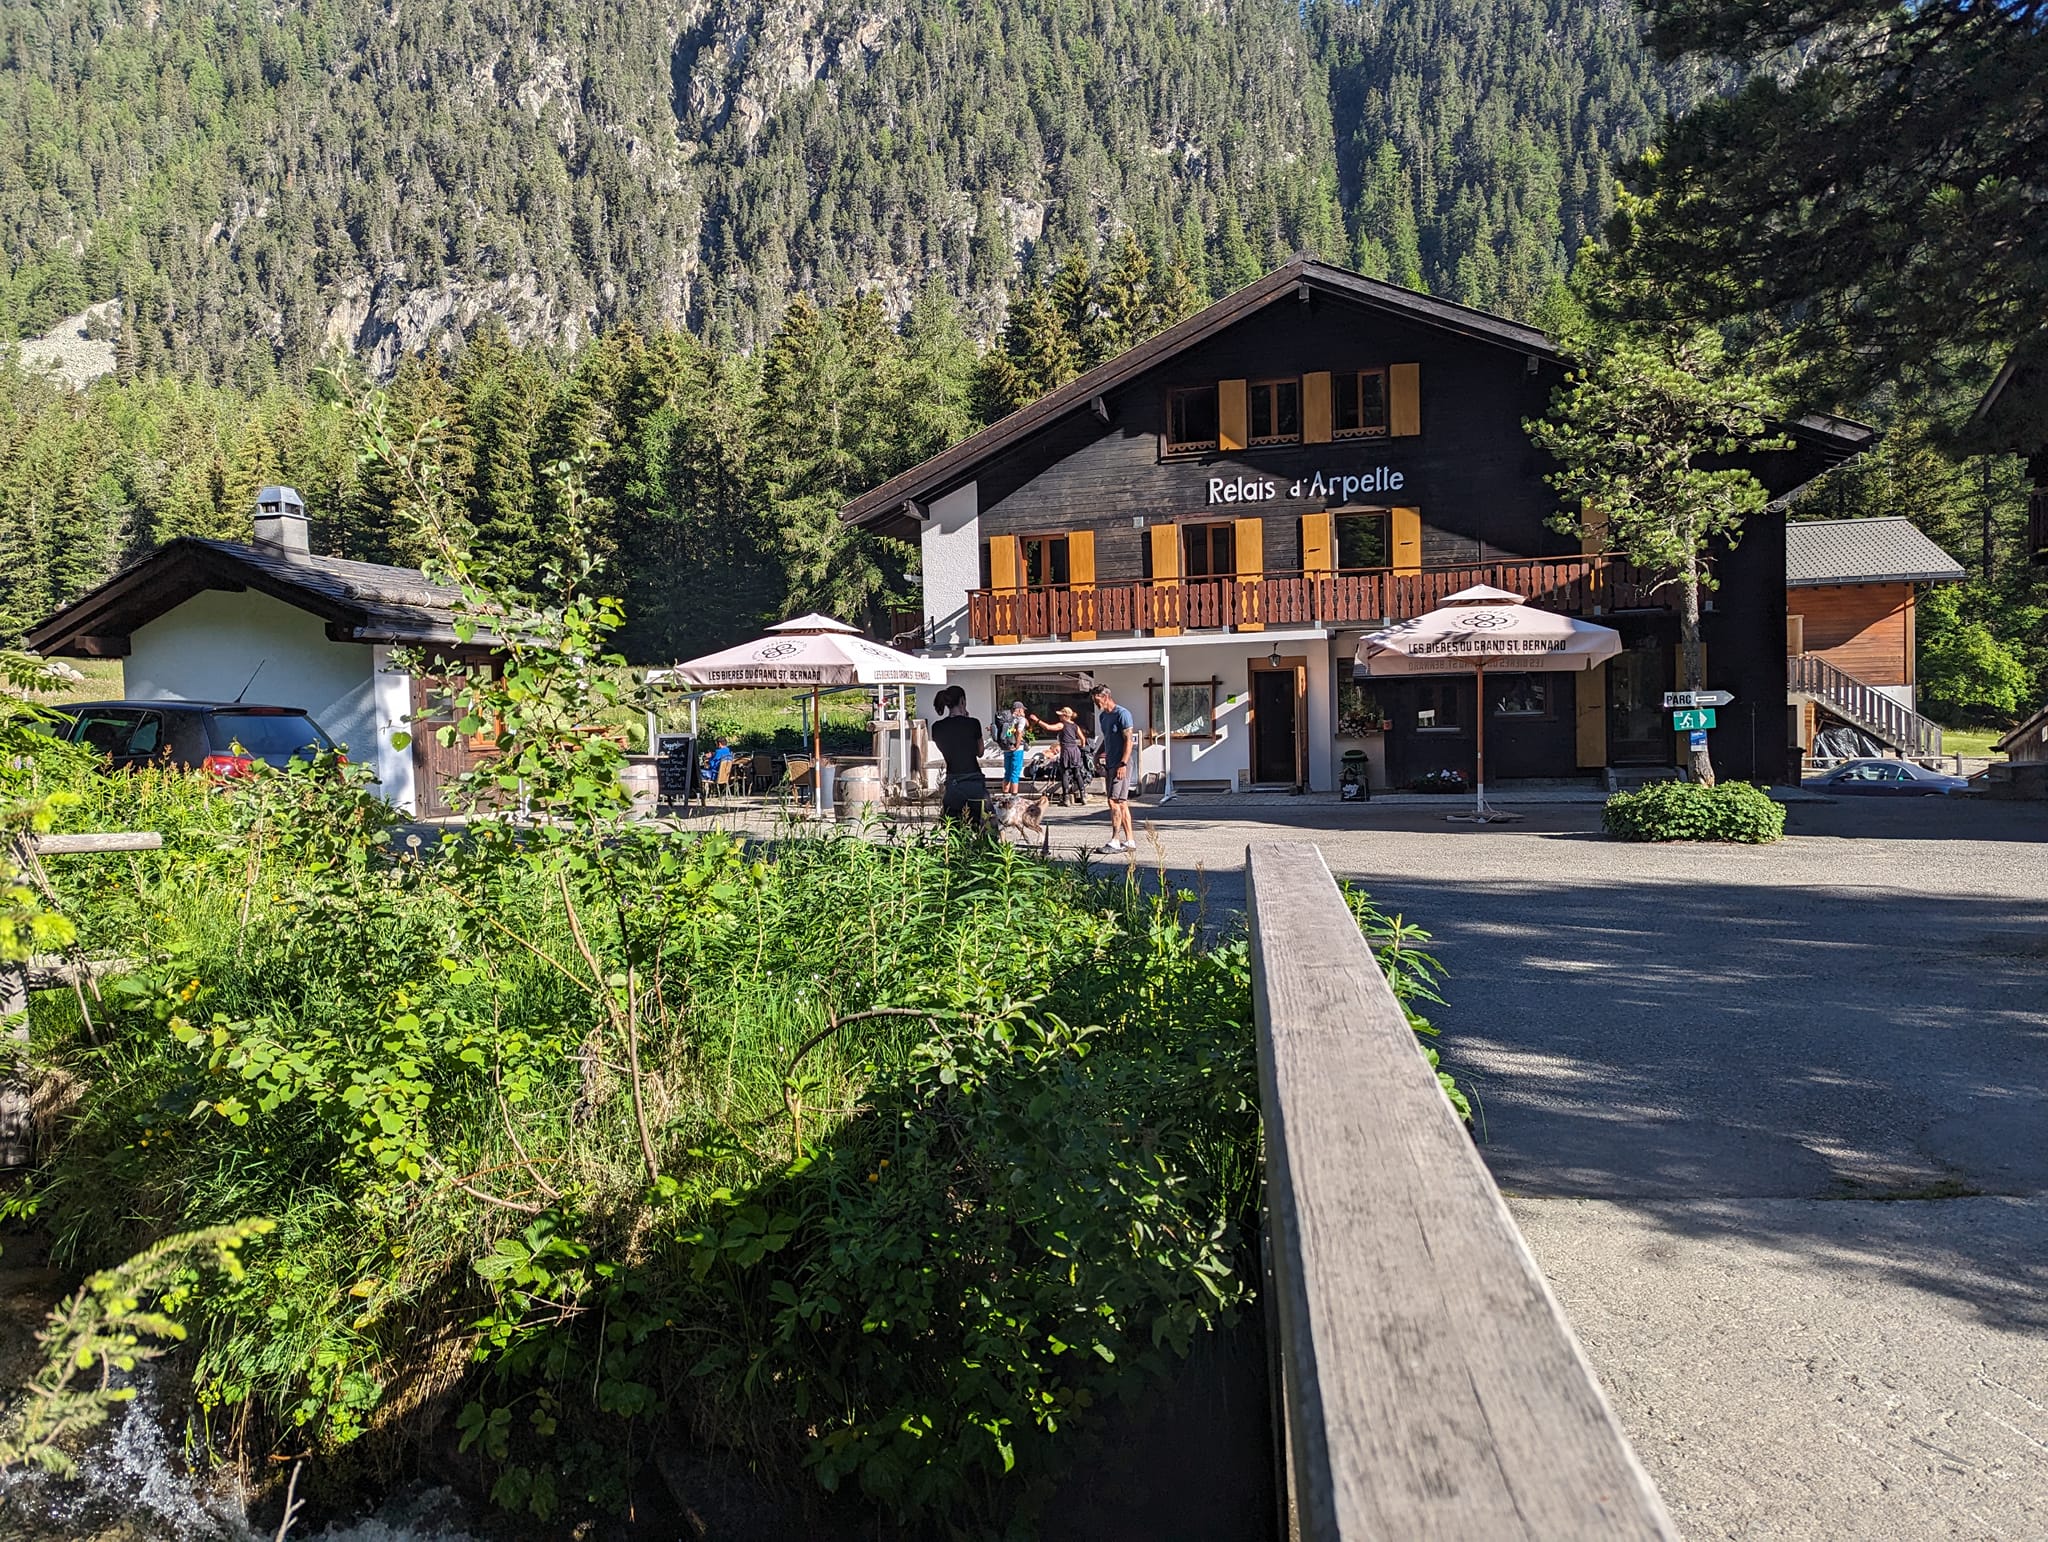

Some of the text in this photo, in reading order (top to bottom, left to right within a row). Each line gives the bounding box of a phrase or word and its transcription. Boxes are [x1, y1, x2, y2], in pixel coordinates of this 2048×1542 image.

[1208, 476, 1276, 504] Relais
[1408, 643, 1424, 655] LES
[1460, 640, 1472, 652] DU
[1473, 640, 1505, 652] GRAND
[1507, 640, 1521, 651] ST.
[1523, 639, 1566, 651] BERNARD
[708, 671, 720, 681] LES
[745, 670, 753, 680] DU
[754, 669, 777, 681] GRAND
[789, 670, 821, 681] BERNARD
[1666, 694, 1692, 705] PARC
